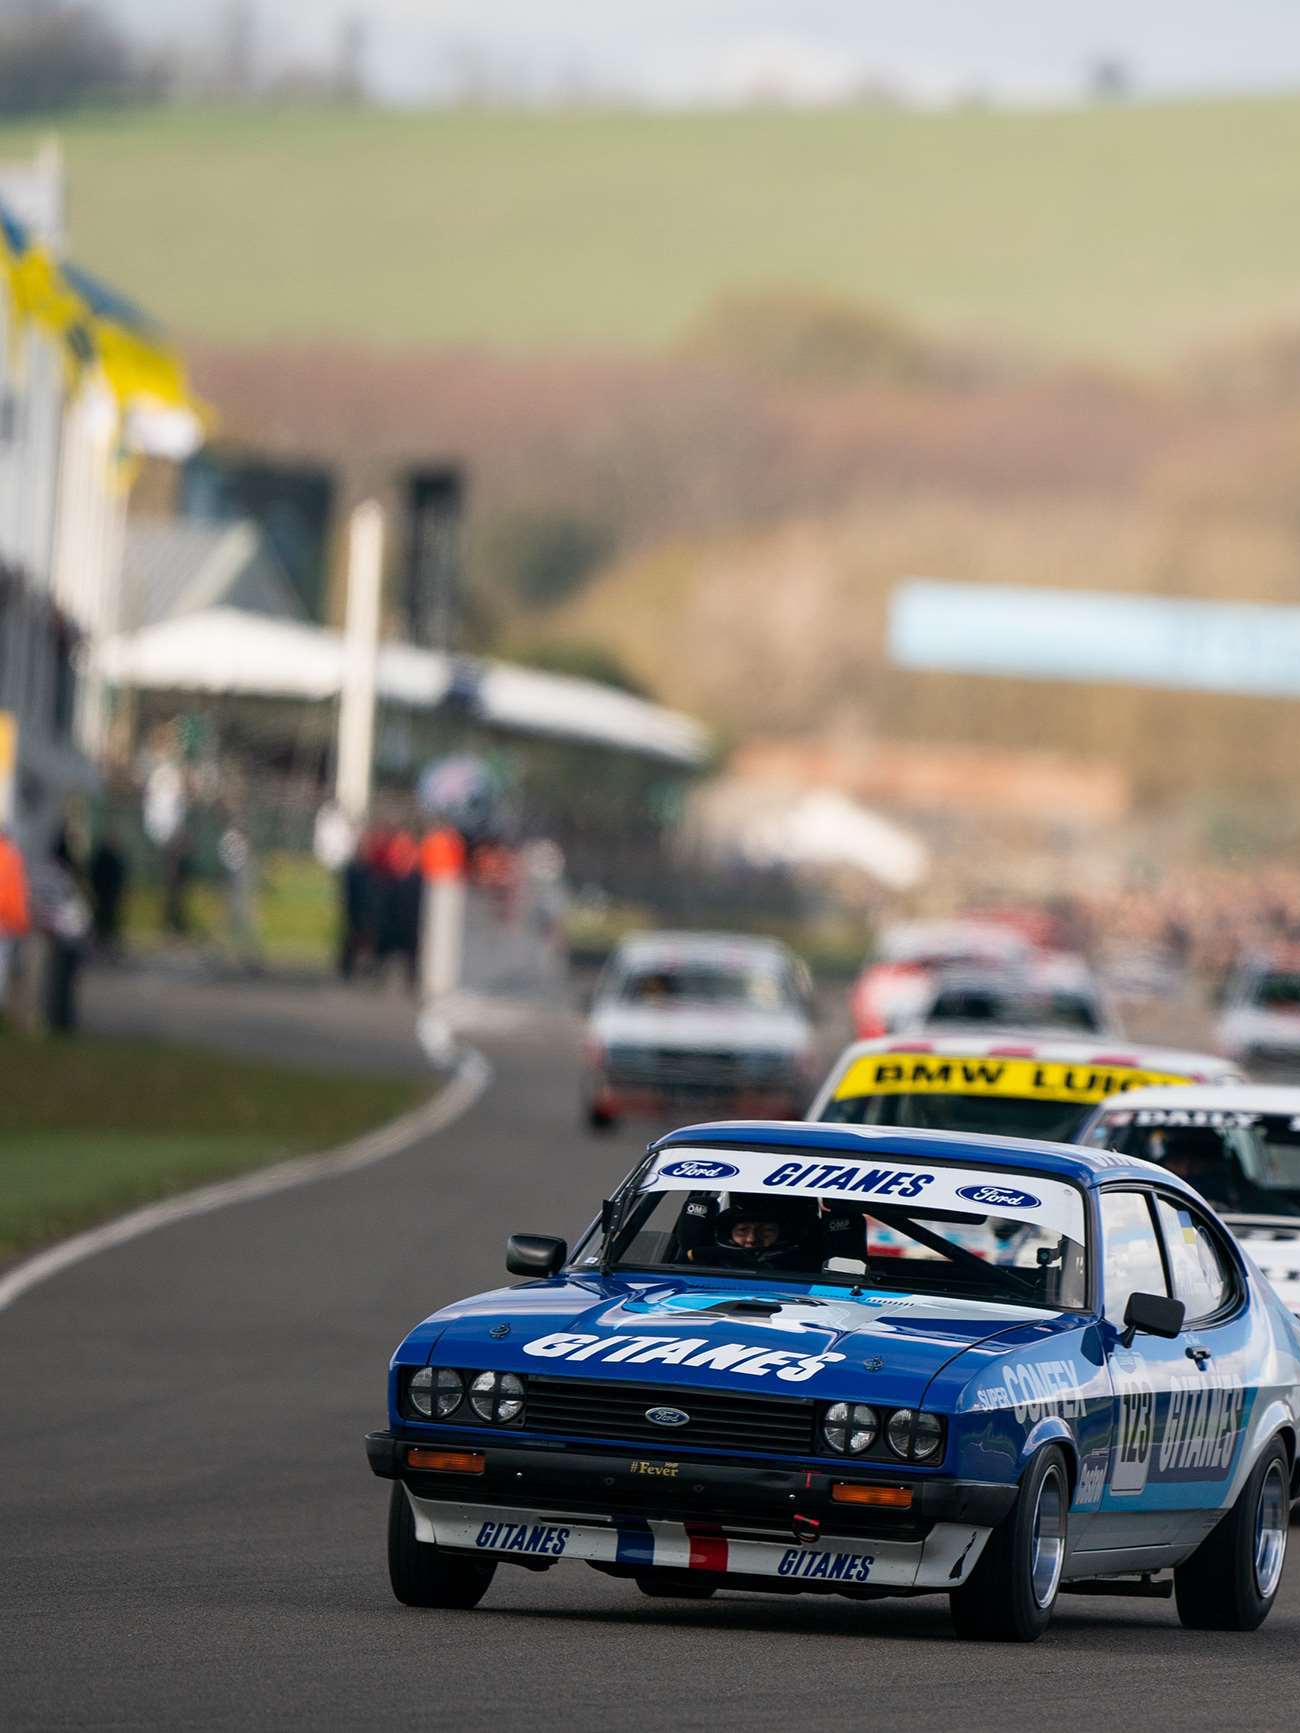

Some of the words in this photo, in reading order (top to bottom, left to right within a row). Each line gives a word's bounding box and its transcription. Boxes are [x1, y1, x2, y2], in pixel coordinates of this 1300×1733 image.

[873, 1062, 1005, 1085] BMW
[1033, 1065, 1152, 1094] LUI
[1135, 1109, 1262, 1130] DAILY
[762, 1162, 936, 1198] GITANES
[523, 1332, 847, 1382] GITANES
[1120, 1380, 1151, 1463] 123
[1158, 1375, 1244, 1473] GITANES
[475, 1520, 570, 1555] GITANES
[777, 1548, 874, 1582] GITANES
